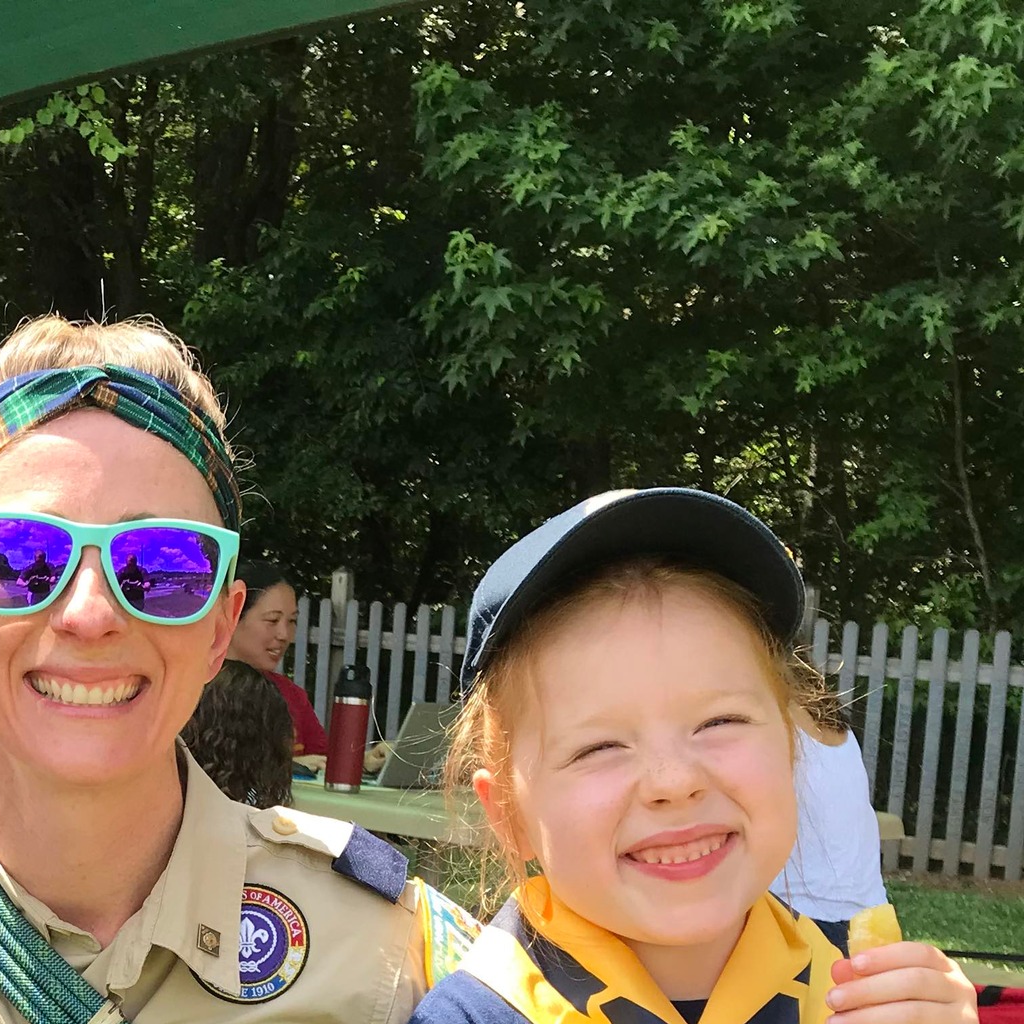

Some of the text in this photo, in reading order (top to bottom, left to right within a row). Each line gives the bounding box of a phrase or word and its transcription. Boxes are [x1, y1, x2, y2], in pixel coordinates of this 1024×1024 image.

[250, 891, 303, 938] OF AMERICA
[251, 982, 275, 997] 1910
